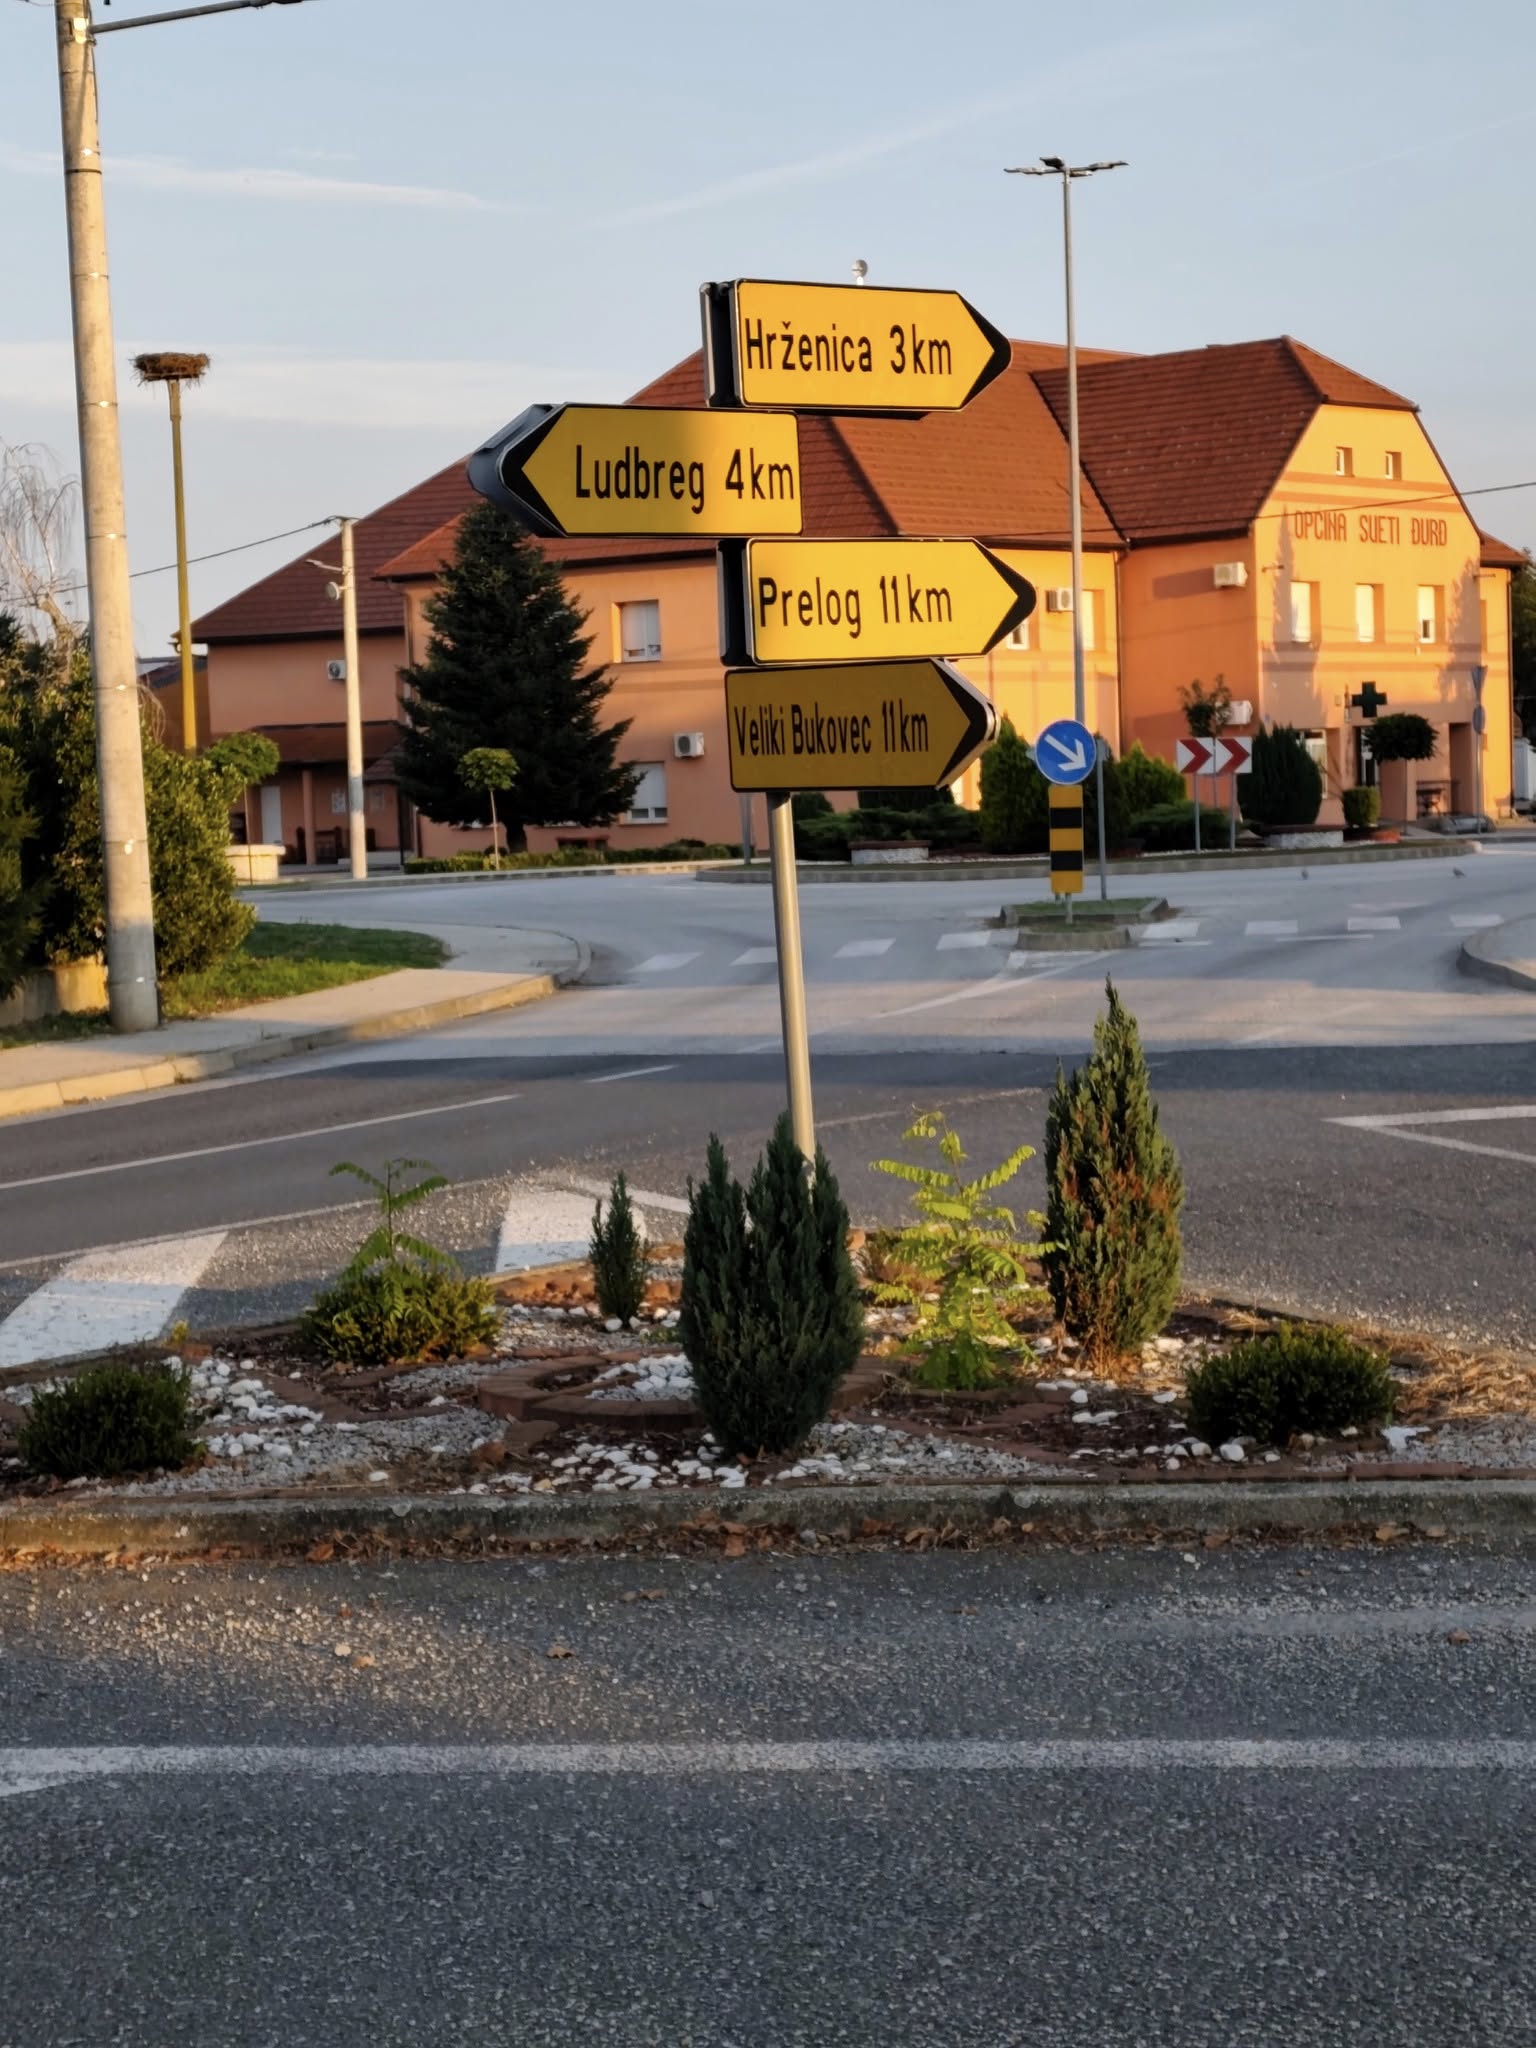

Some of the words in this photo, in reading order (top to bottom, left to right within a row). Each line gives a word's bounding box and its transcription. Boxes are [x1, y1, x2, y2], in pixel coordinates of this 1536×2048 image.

[744, 318, 873, 372] Hrženica
[576, 444, 705, 514] Ludbreg
[758, 576, 861, 639] Prelog
[734, 704, 786, 756] Veliki
[791, 701, 872, 755] Bukovec
